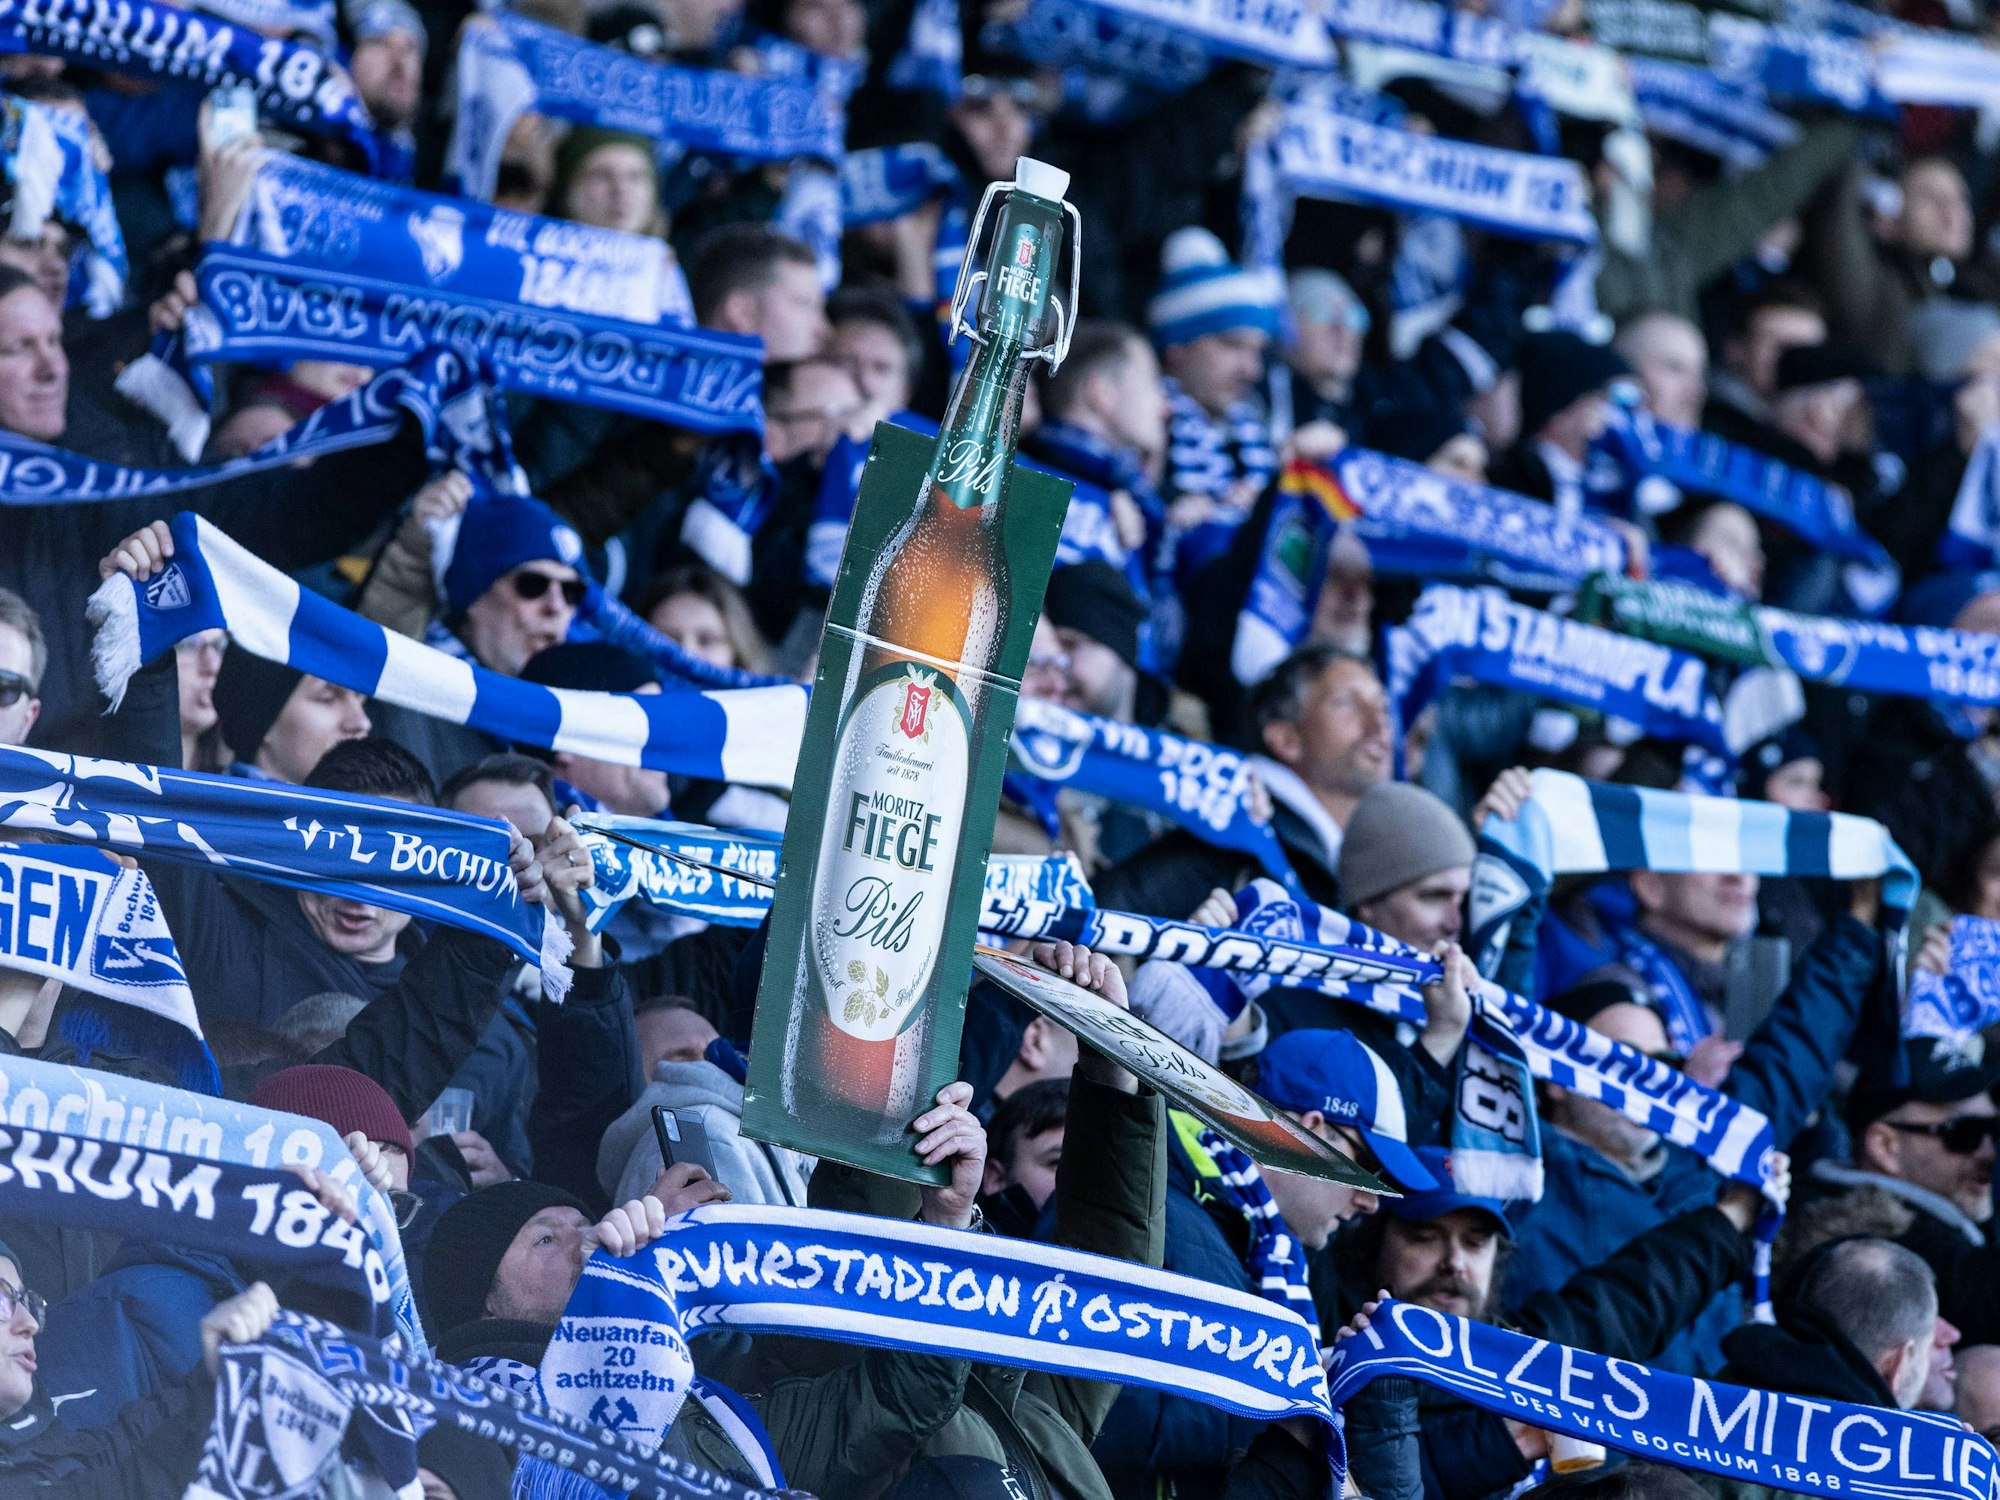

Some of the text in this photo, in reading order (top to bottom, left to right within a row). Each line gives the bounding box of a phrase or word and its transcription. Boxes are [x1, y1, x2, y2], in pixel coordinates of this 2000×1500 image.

[996, 264, 1042, 306] FIEGE
[1009, 265, 1034, 281] MORITZ
[209, 267, 370, 340] 1848
[379, 292, 674, 395] BOCHUM
[936, 438, 1004, 494] Pils
[875, 743, 935, 772] Familienbrauerei
[886, 764, 921, 783] seit 1878
[842, 790, 942, 874] FIEGE
[870, 789, 925, 823] MORITZ
[627, 845, 714, 897] ALLES
[832, 875, 925, 954] Pils
[1119, 1039, 1208, 1080] Pils
[1504, 994, 1728, 1135] BOCHUM
[1322, 1094, 1361, 1118] 1848
[652, 1239, 1021, 1318] RUHRSTADION
[555, 1369, 676, 1393] achtzehn
[602, 1345, 637, 1368] 20
[456, 1409, 578, 1467] BOCHUM
[1510, 1390, 1841, 1490] DES VfL BOCHUM 1848
